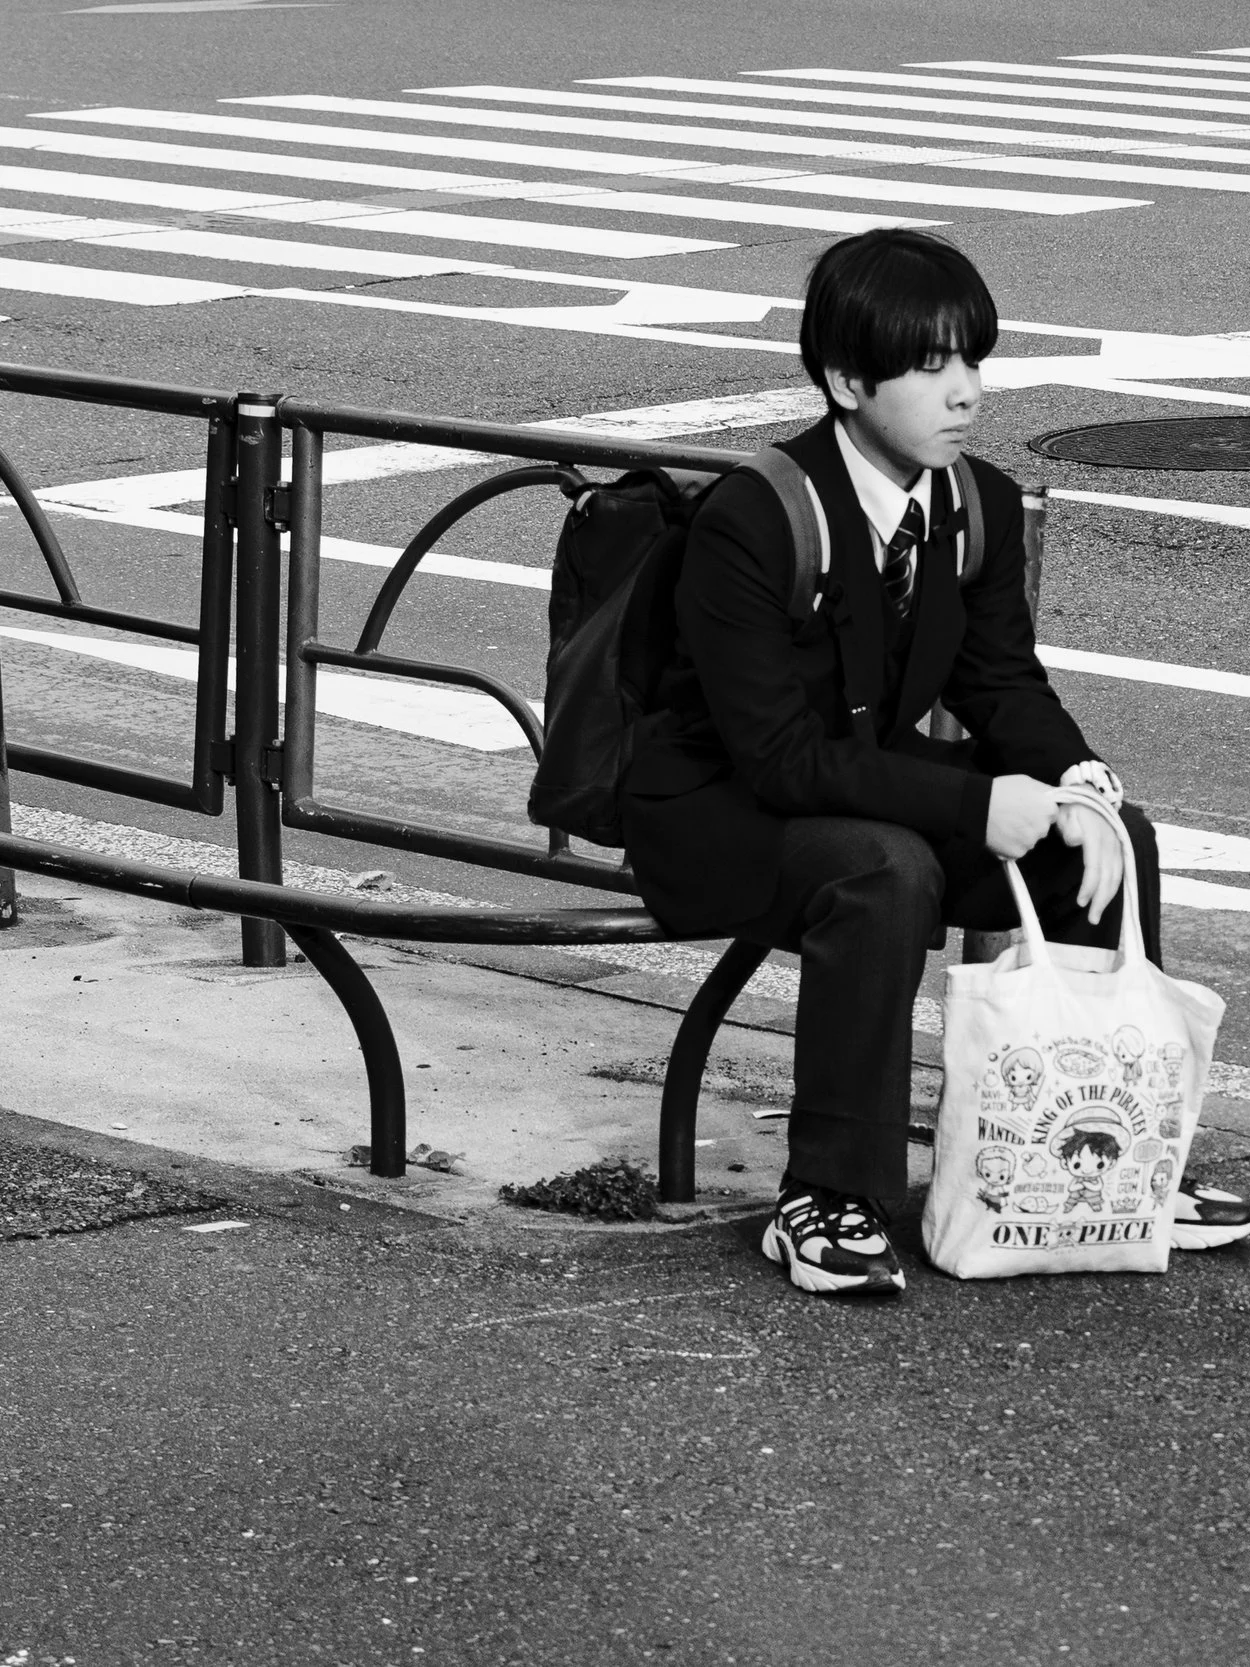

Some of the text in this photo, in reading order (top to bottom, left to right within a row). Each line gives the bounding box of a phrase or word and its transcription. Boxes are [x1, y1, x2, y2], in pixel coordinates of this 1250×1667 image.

[1031, 1084, 1148, 1145] KING OF THE PIRATES
[978, 1116, 1025, 1146] WANTED
[993, 1220, 1155, 1246] ONE PIECE
